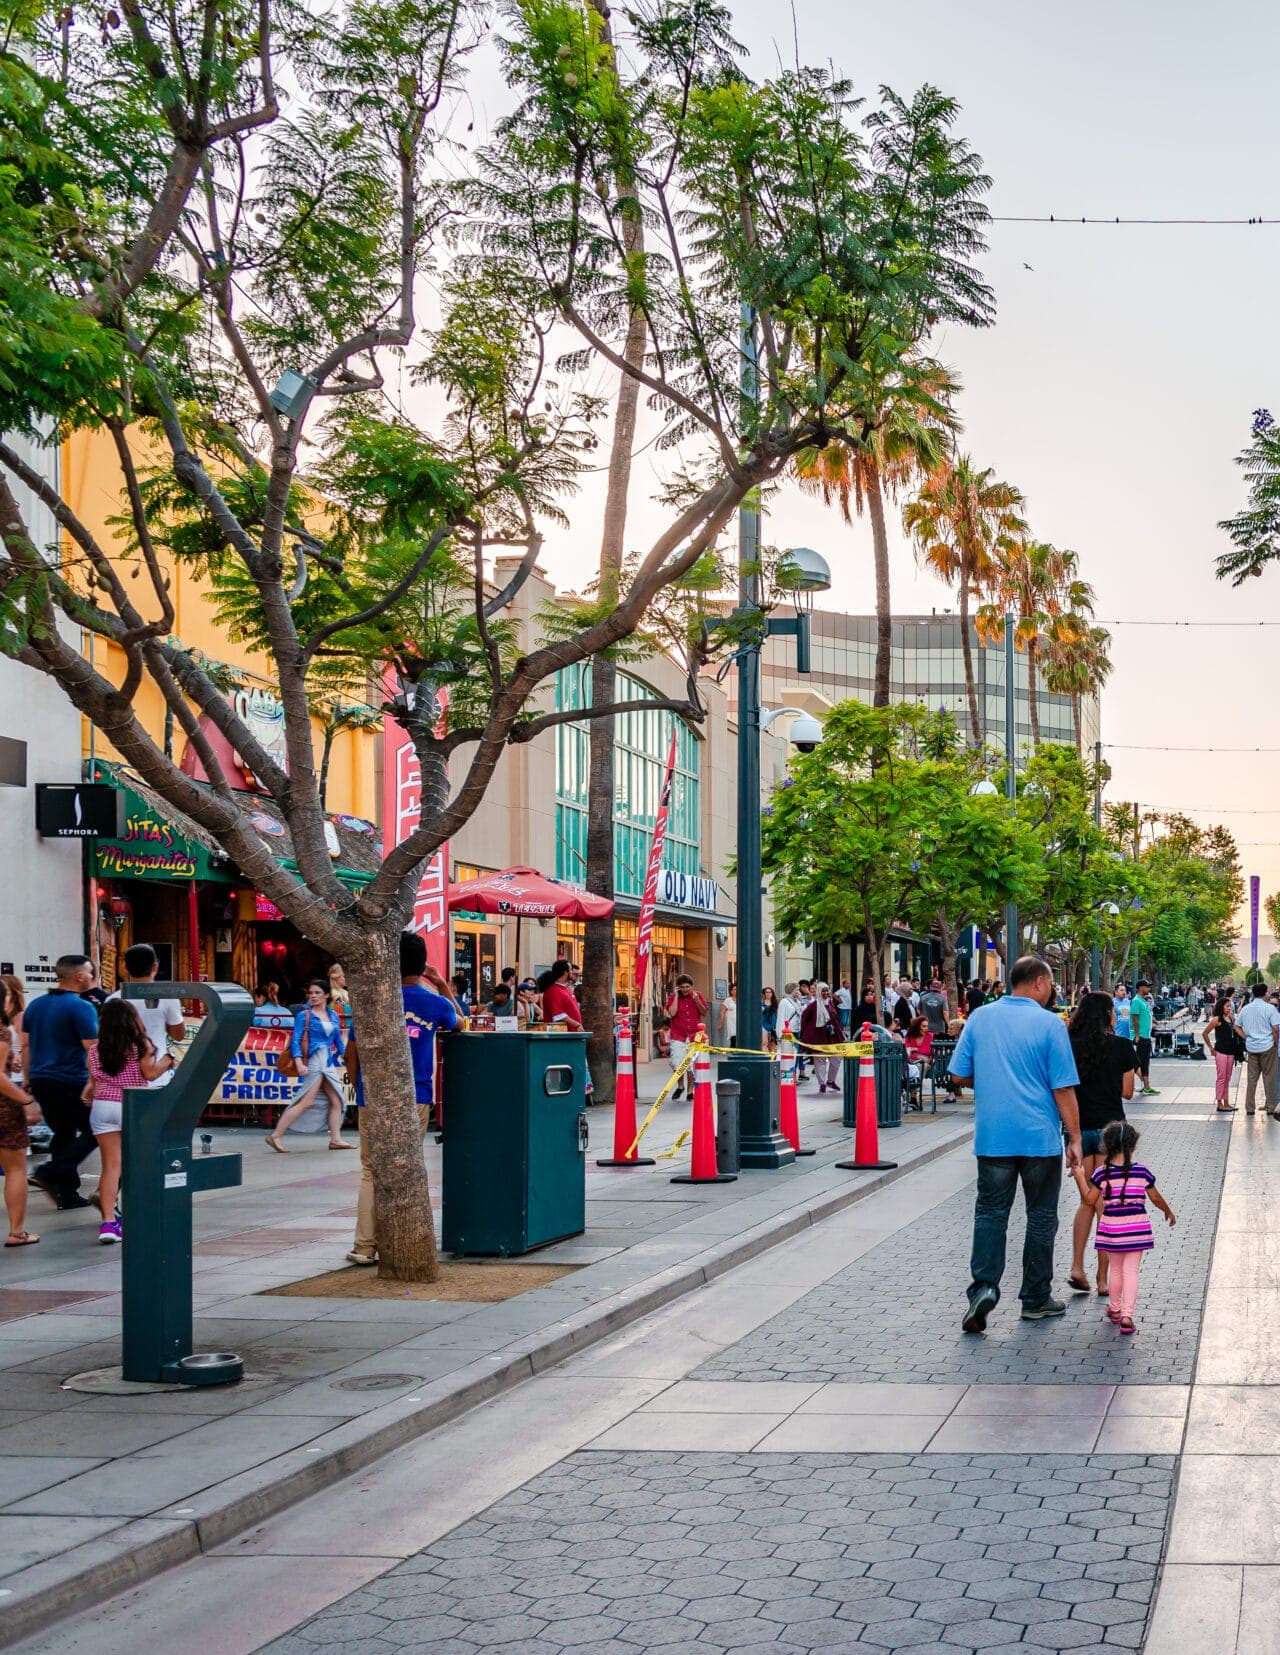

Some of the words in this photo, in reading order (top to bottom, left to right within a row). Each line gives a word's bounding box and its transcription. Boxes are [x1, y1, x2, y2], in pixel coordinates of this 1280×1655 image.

[96, 846, 198, 876] Margaritas
[665, 869, 687, 905] OLD
[691, 877, 718, 912] NAVY
[223, 1069, 238, 1083] 2
[243, 1068, 288, 1083] FOR
